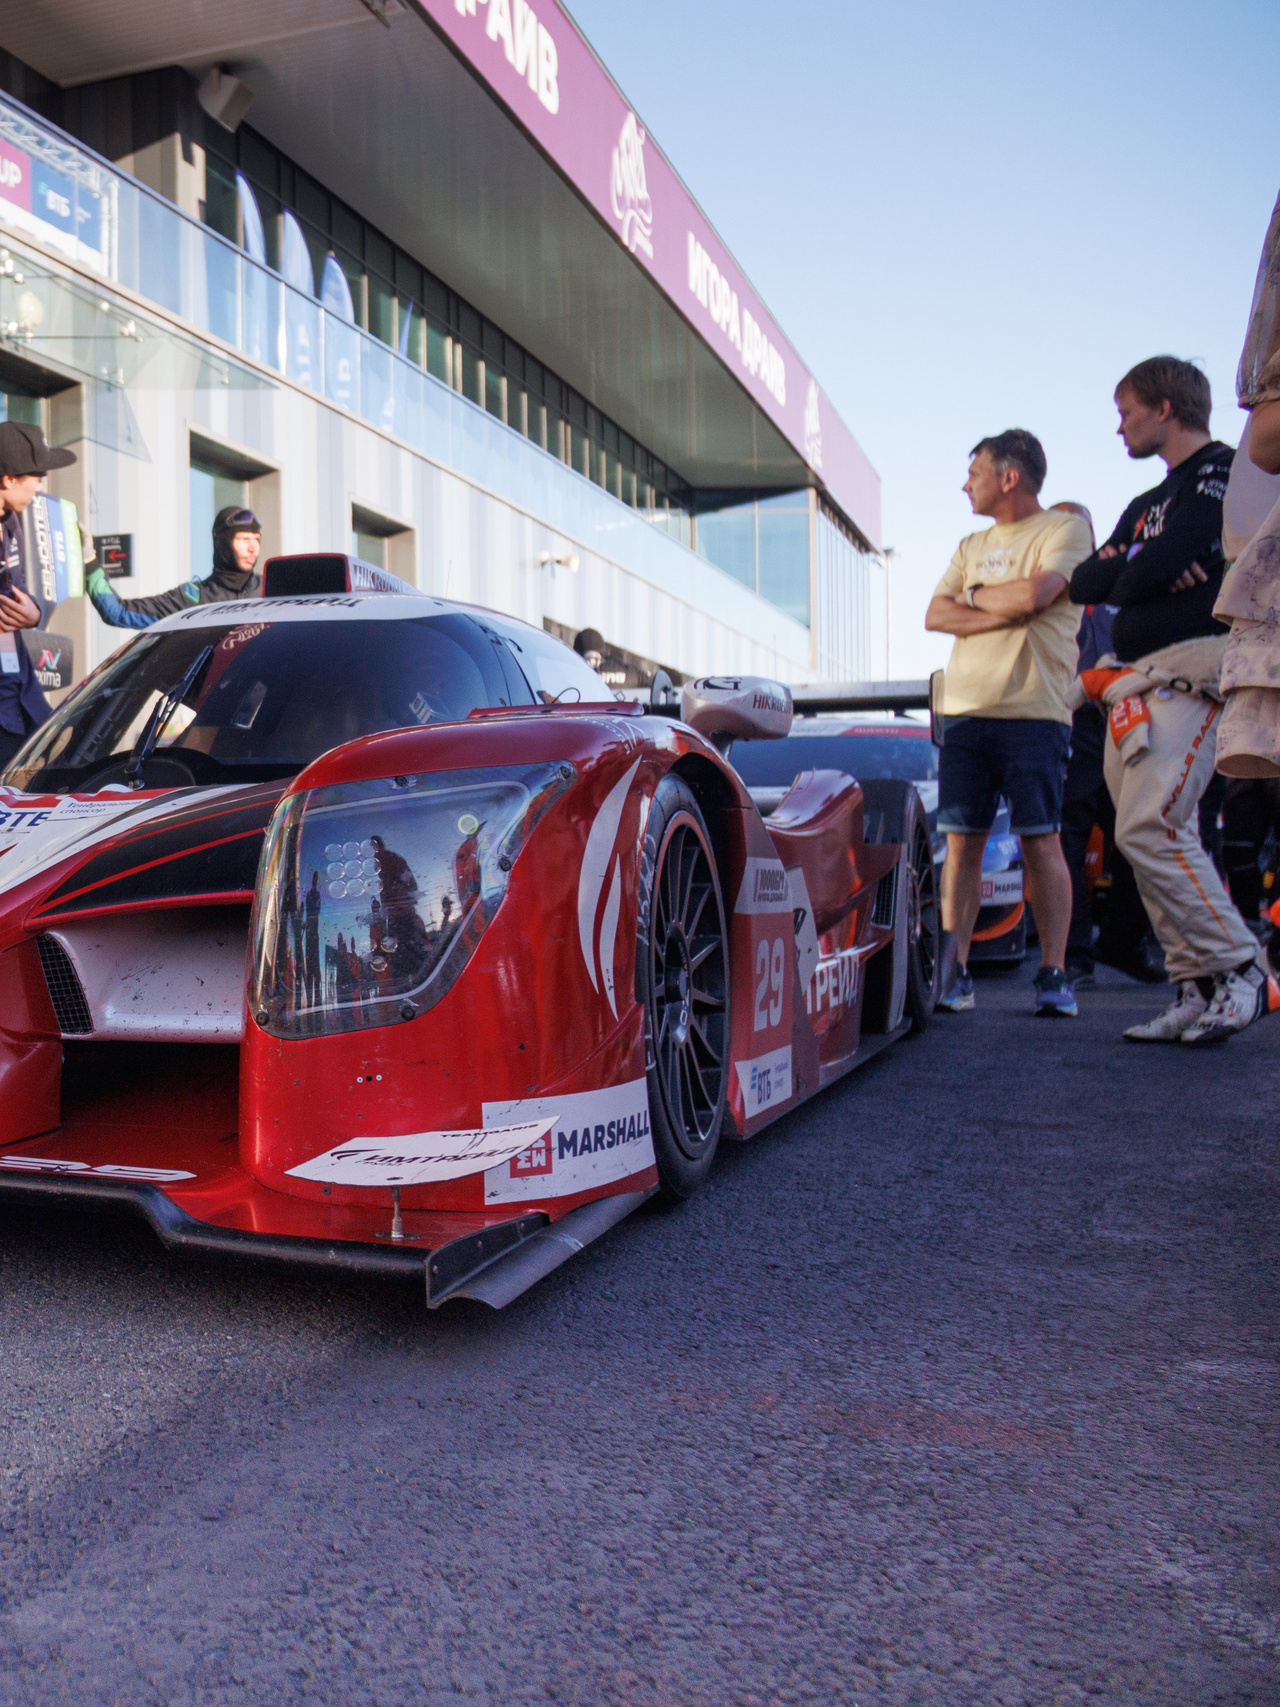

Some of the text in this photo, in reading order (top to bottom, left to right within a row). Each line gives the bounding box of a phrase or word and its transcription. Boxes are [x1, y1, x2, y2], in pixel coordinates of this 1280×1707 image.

[687, 230, 742, 352] ИГОРА
[753, 936, 785, 1033] 29
[757, 1068, 772, 1105] ВТБ
[557, 1109, 651, 1160] MARSHALL
